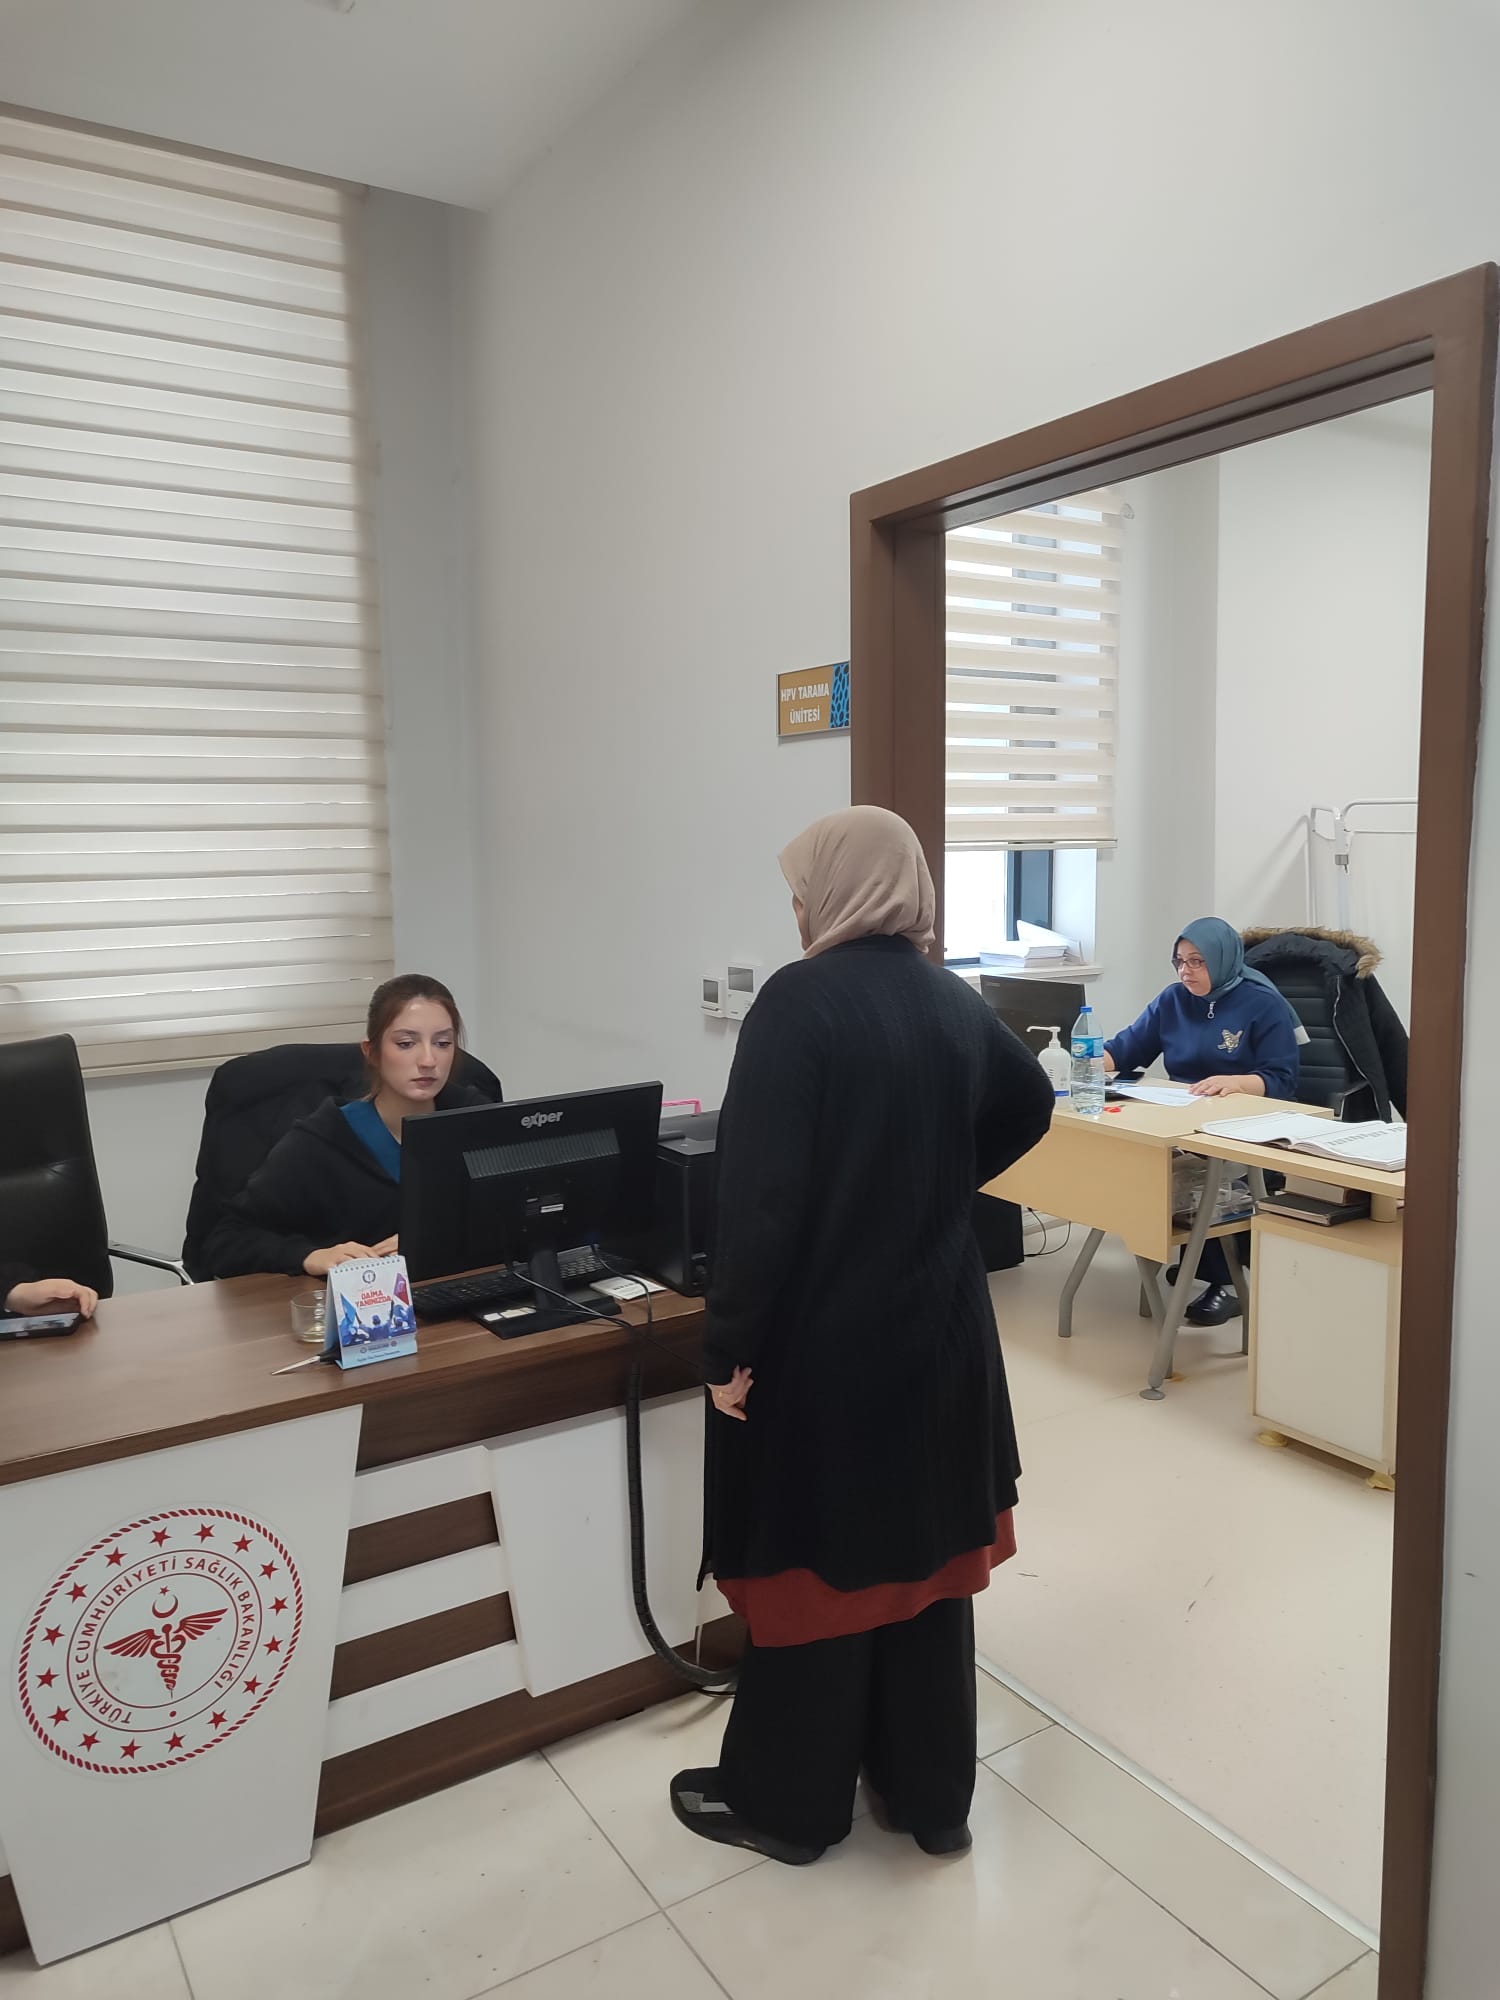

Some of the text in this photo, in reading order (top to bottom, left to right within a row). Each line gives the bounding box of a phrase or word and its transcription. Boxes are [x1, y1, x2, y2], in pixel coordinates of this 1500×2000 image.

[781, 683, 830, 702] HPV TARAMA
[790, 705, 820, 724] ÜNİTESİ
[521, 1112, 564, 1128] exper
[75, 1555, 255, 1725] TÜRKİYE CUMHURİYETİ SAĞLIK BAKANLIĞI
